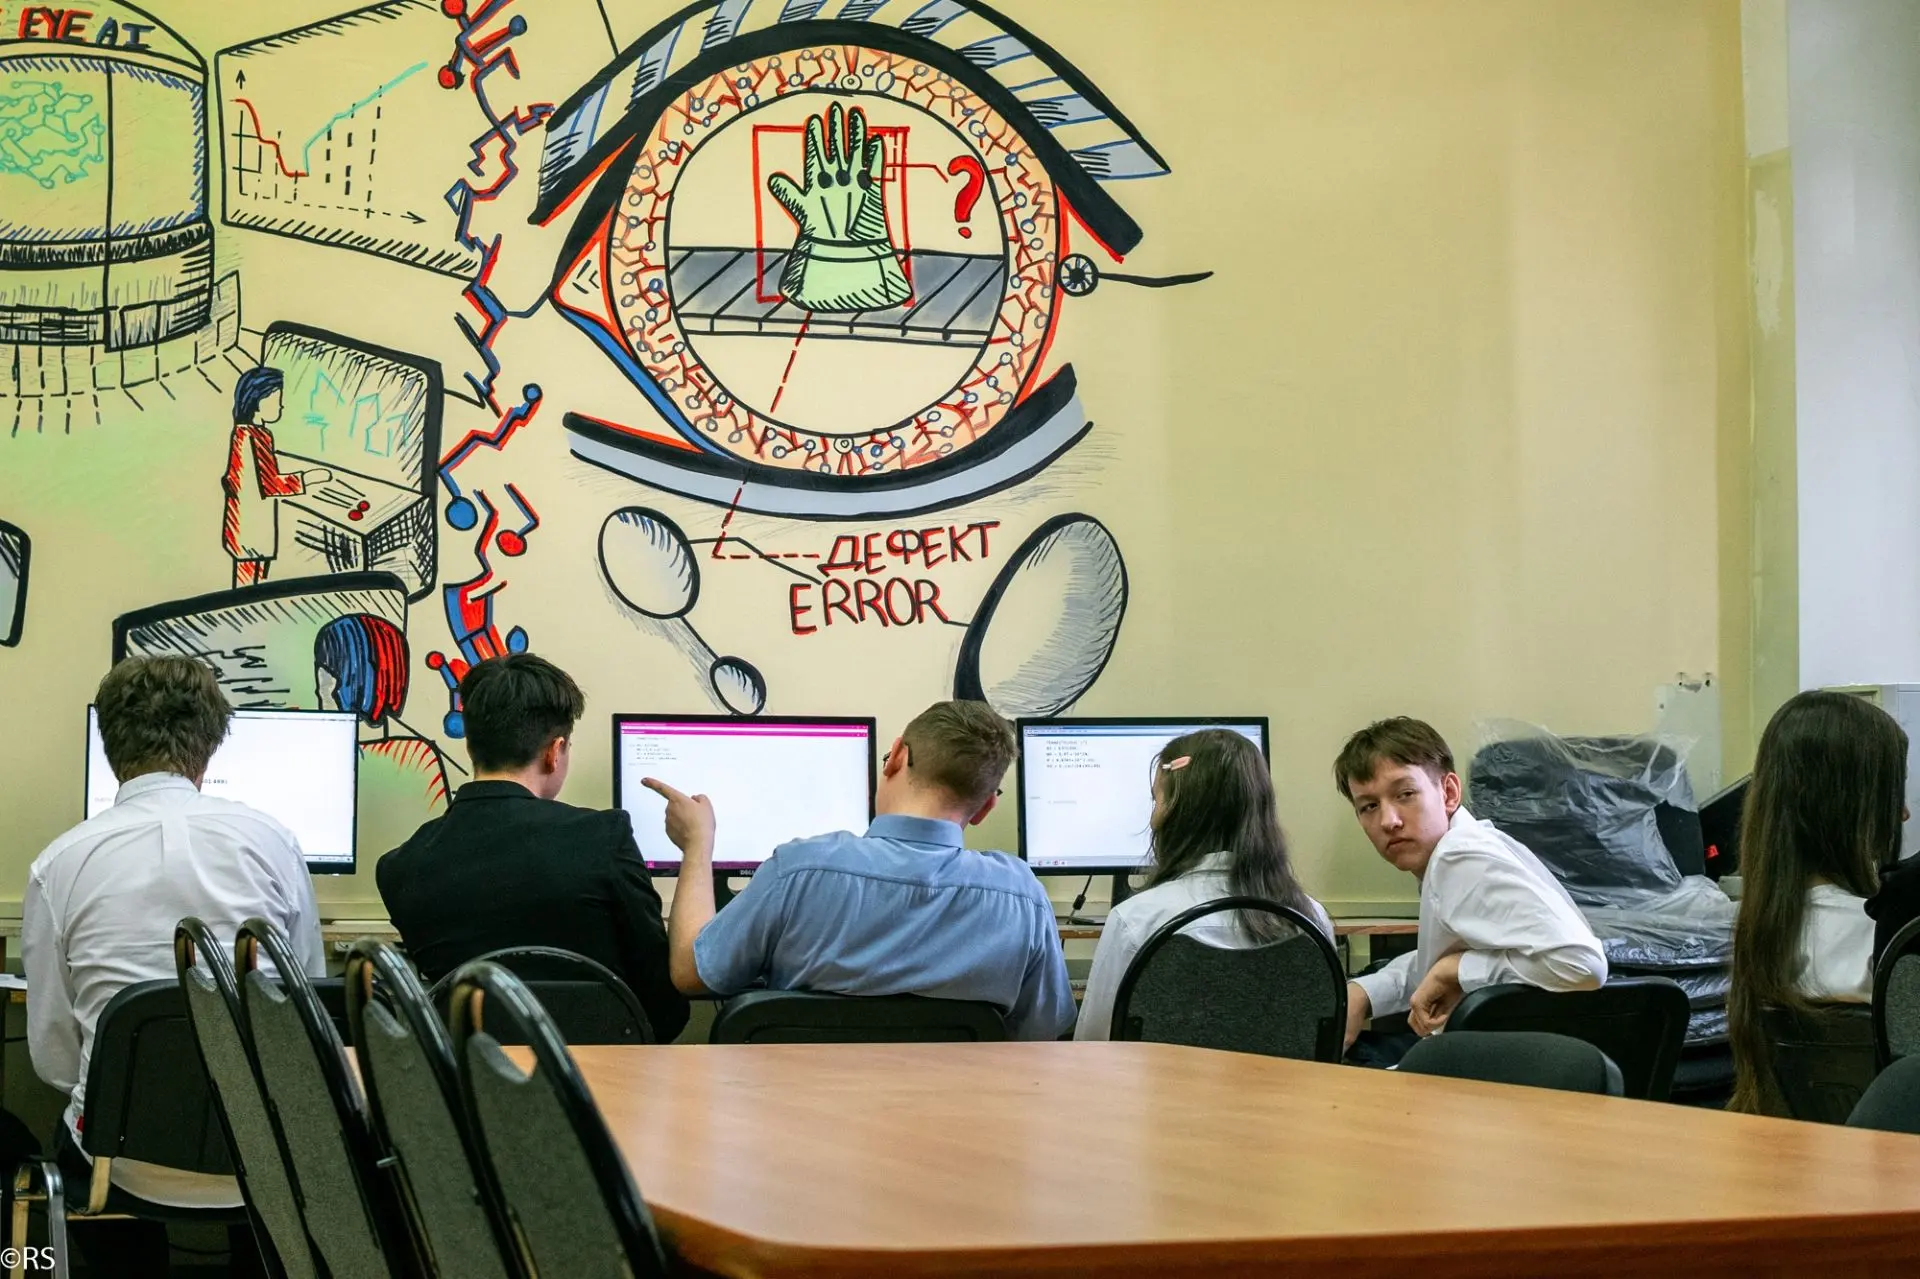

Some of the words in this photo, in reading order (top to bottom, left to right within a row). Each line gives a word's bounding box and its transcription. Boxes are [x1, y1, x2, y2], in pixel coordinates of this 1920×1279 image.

[18, 6, 93, 42] EYE
[96, 16, 156, 50] AI
[947, 154, 985, 239] ?
[817, 520, 1001, 577] ДЕФЕКТ
[789, 576, 950, 635] ERROR
